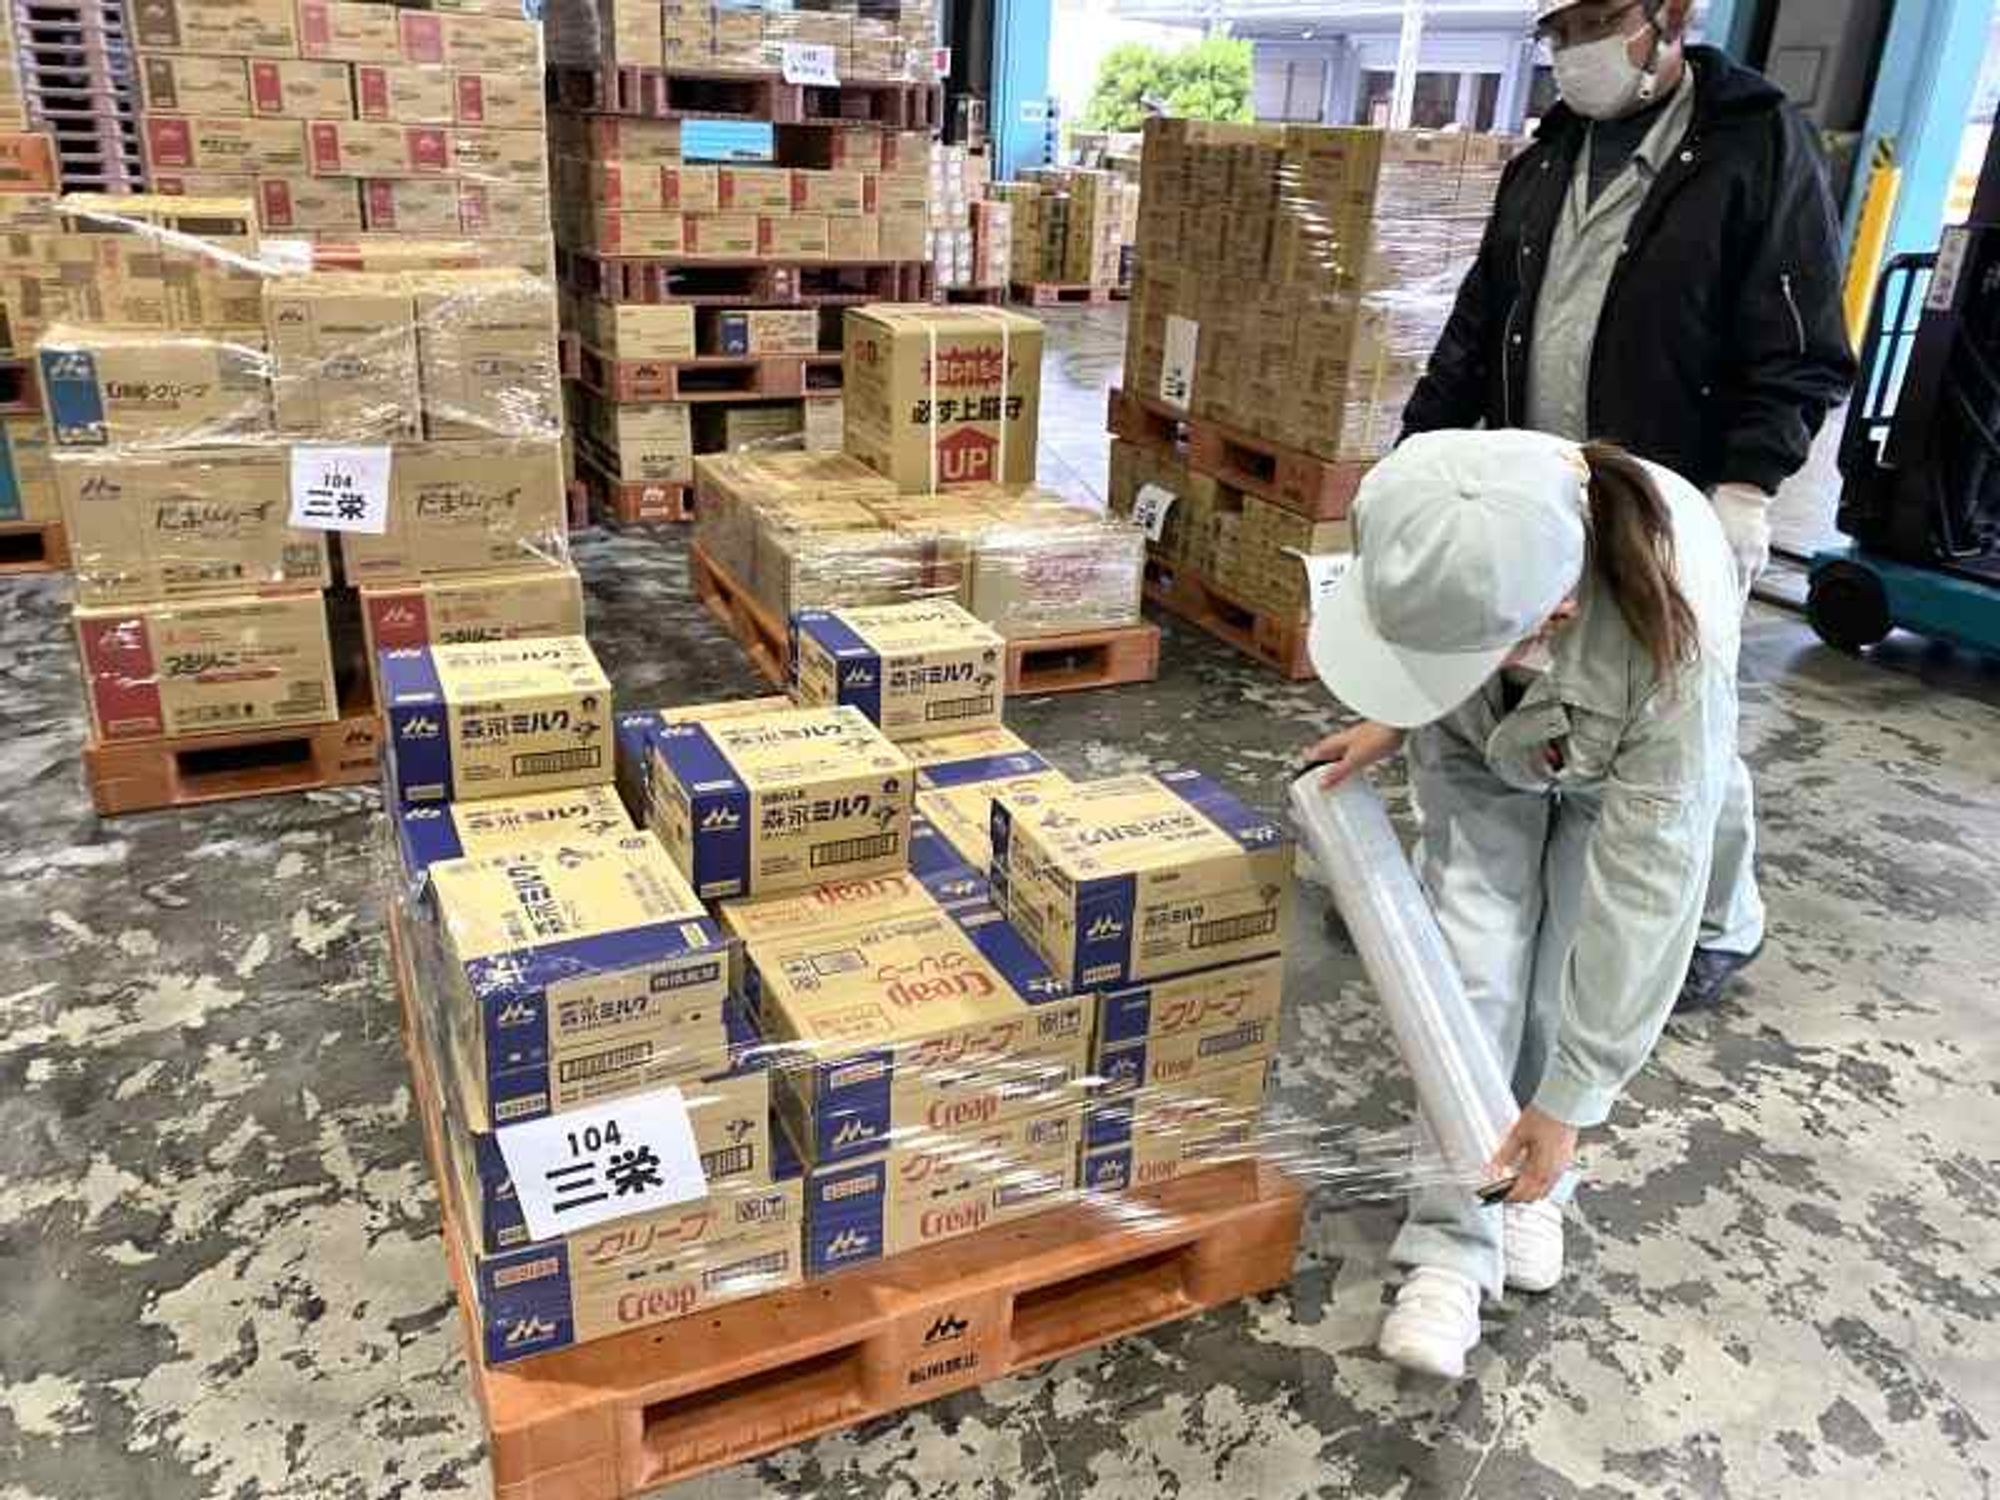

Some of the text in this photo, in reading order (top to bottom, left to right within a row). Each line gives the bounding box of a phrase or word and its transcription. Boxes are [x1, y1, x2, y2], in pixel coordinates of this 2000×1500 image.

[322, 474, 353, 489] 104
[942, 447, 989, 479] UP
[303, 489, 368, 519] 三栄
[761, 794, 871, 831] 森永ミルク
[566, 1119, 622, 1157] 104
[545, 1145, 663, 1213] 三栄
[616, 1283, 698, 1324] Creap
